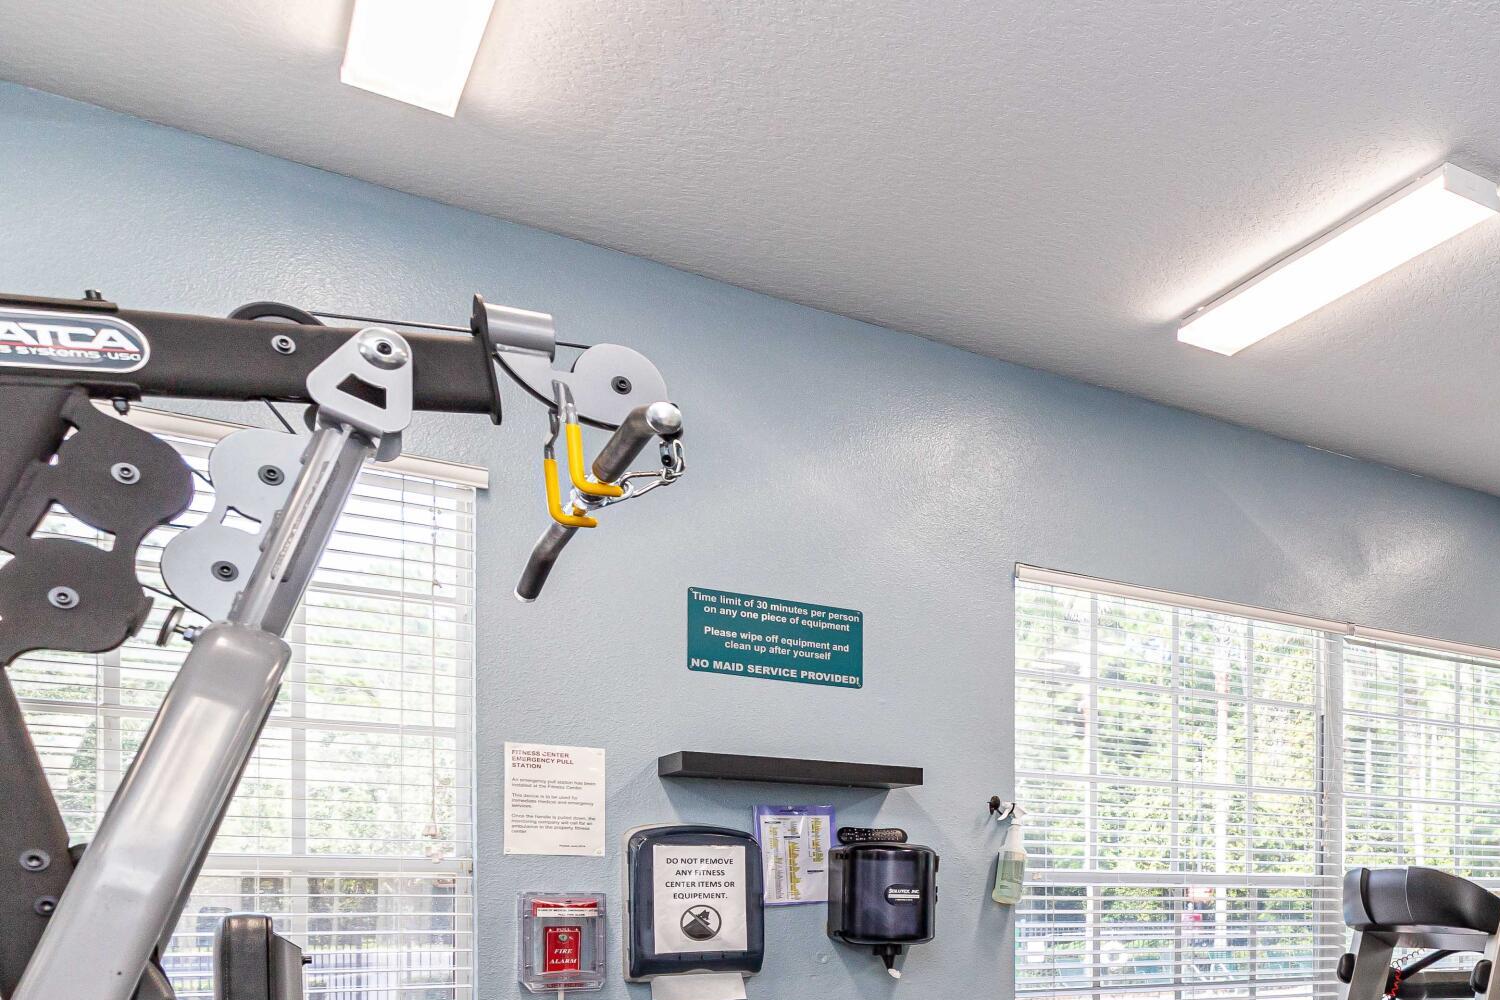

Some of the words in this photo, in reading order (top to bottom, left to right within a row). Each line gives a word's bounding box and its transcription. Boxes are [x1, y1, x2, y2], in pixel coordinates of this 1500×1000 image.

[692, 591, 717, 603] Time
[720, 595, 741, 606] limit
[744, 599, 754, 608] of
[756, 601, 768, 610] 30
[770, 603, 808, 616] minutes
[810, 609, 826, 618] per
[828, 612, 860, 623] person
[703, 606, 717, 614] on
[719, 608, 737, 618] any
[740, 611, 758, 619] one
[761, 613, 787, 623] piece
[790, 616, 800, 625] of
[801, 619, 850, 632] equipment
[704, 626, 737, 638] Please
[740, 631, 762, 642] wipe
[766, 633, 779, 643] off
[781, 637, 830, 650] equipment
[832, 643, 849, 652] and
[724, 641, 751, 651] clean
[754, 645, 766, 653] up
[769, 646, 790, 656] after
[793, 650, 831, 661] yourself
[691, 658, 709, 667] NO
[713, 660, 743, 672] MAID
[747, 664, 797, 678] SERVICE
[800, 670, 860, 685] PROVIDED!
[512, 756, 555, 764] EMERGENCY
[666, 857, 679, 865] DO
[694, 869, 725, 877] FITNESS
[673, 892, 728, 900] EQUIPEMENT.
